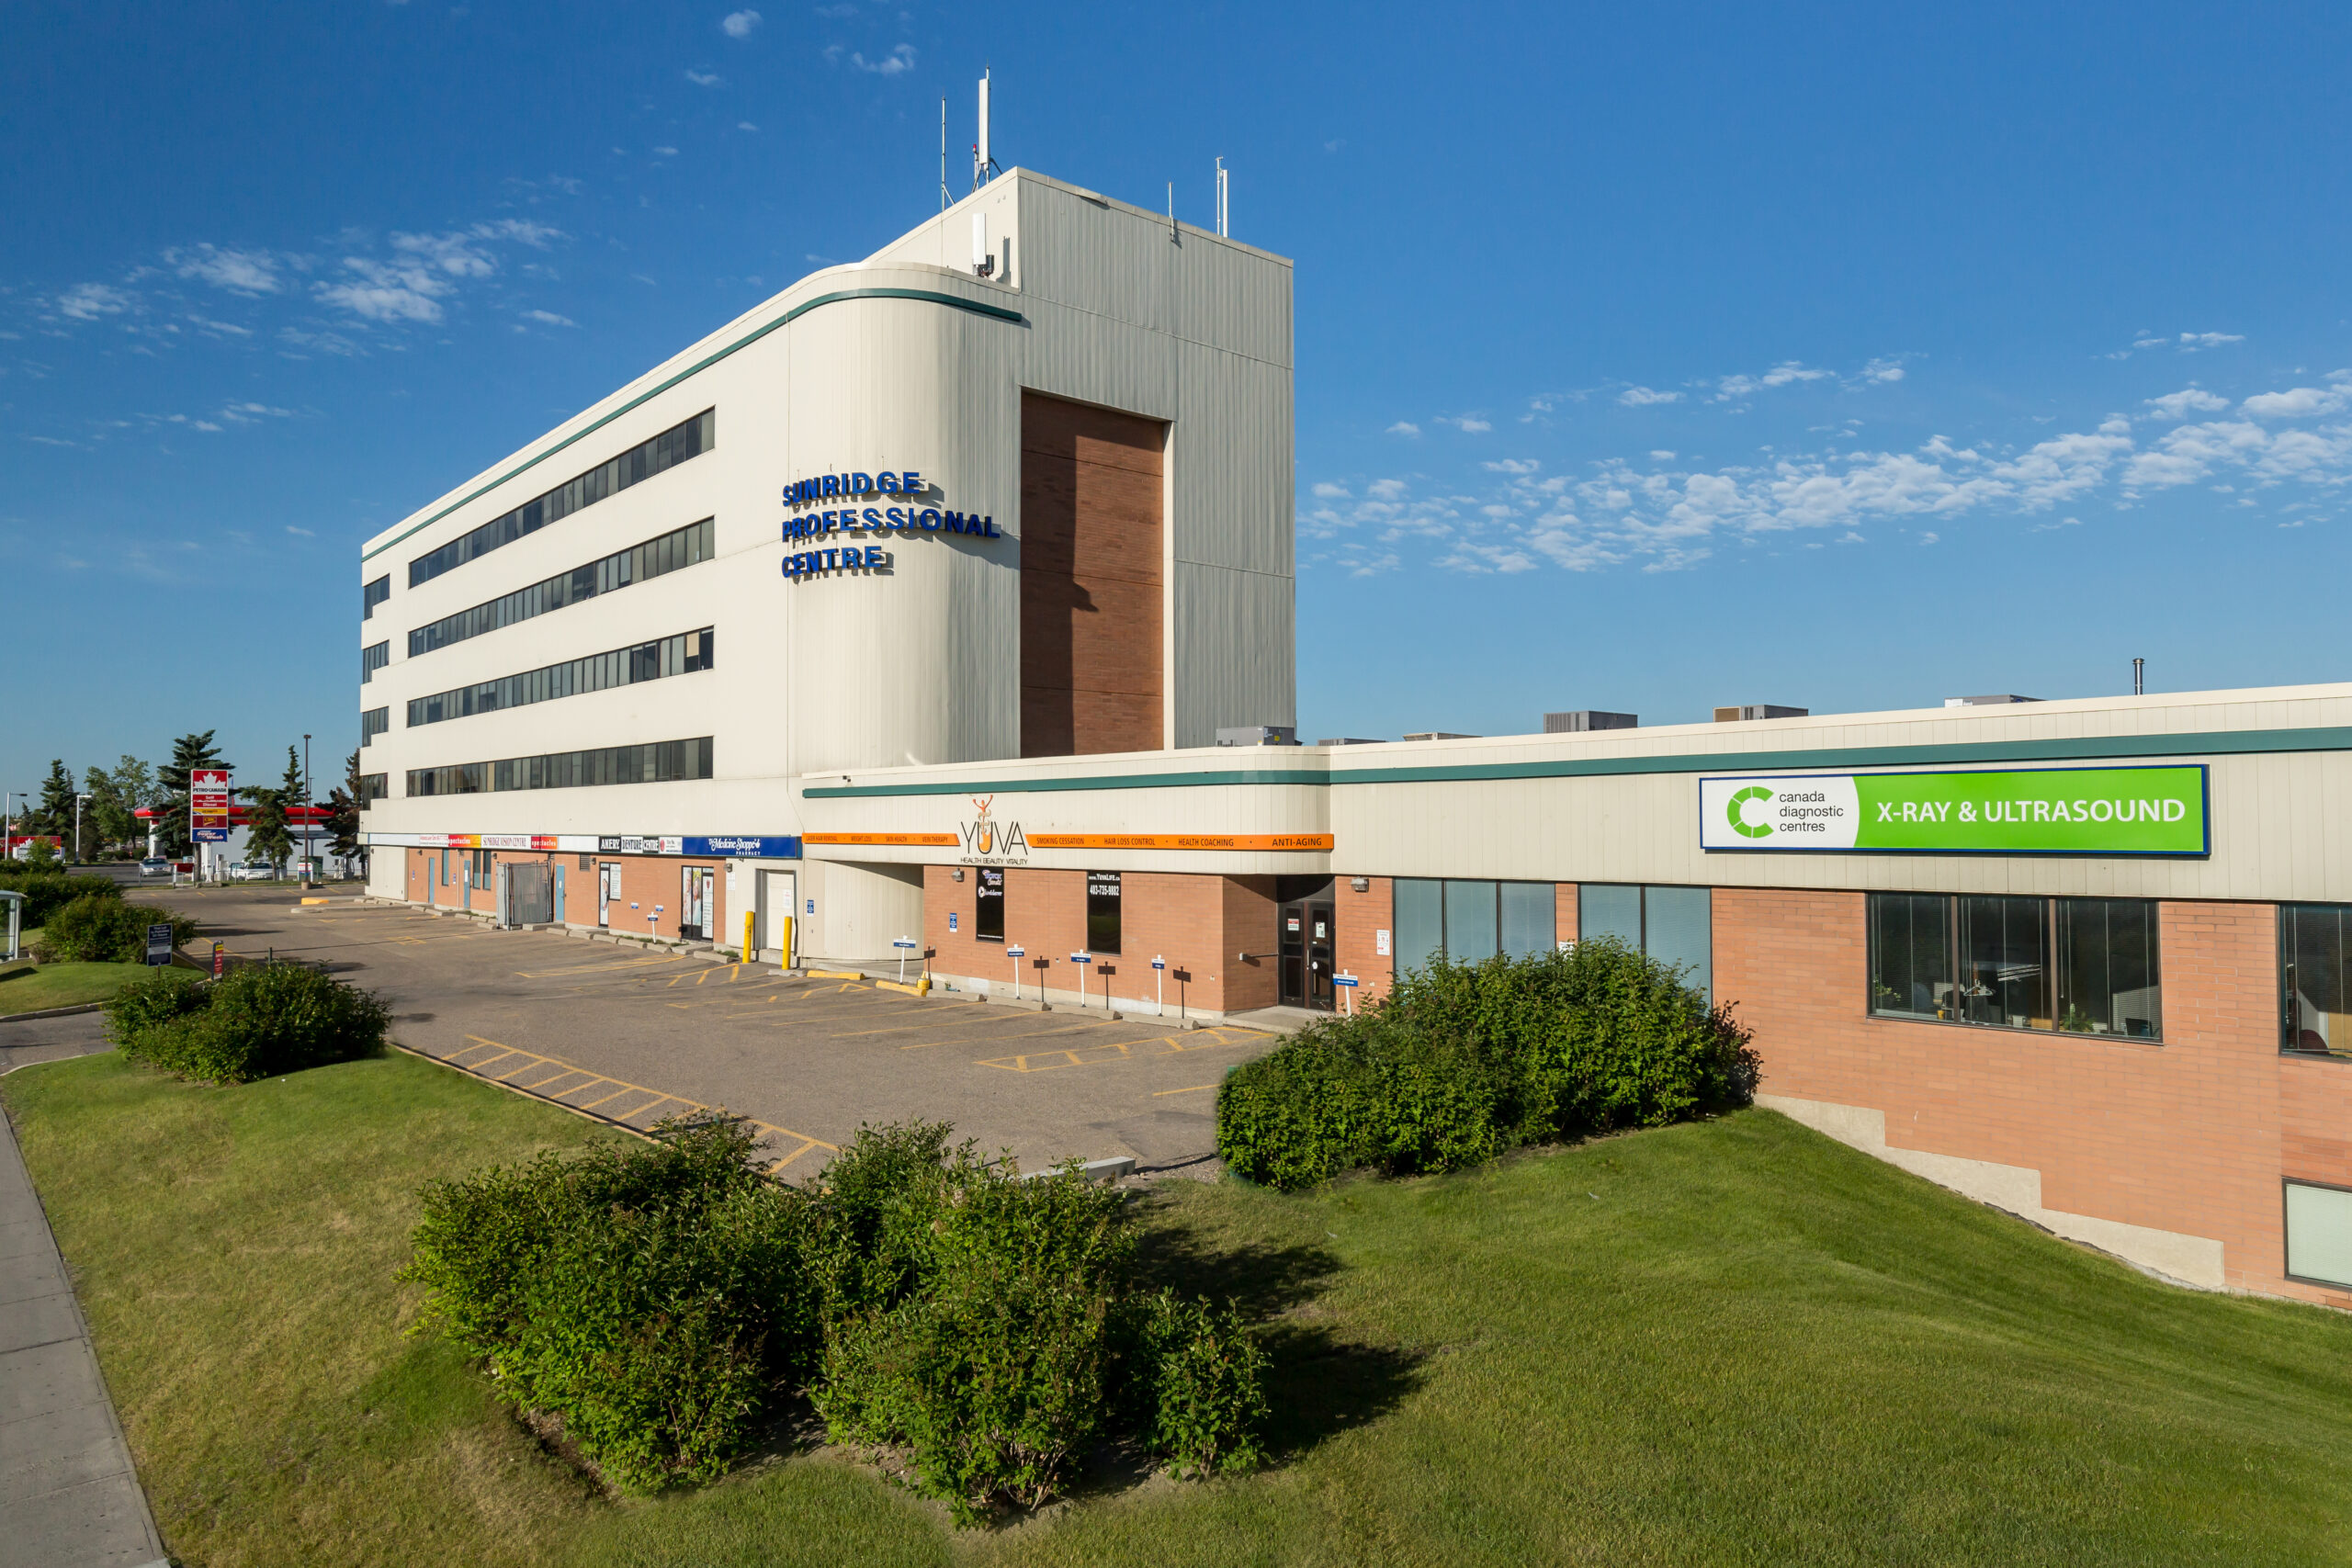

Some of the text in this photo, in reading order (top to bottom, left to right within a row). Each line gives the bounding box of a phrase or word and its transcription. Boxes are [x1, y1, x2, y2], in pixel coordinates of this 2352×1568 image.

[783, 471, 920, 506] SUNRIDGE
[782, 507, 1001, 542] PROFESSIONAL
[782, 546, 882, 578] CENTRE
[1779, 791, 1826, 803] canada
[1779, 806, 1844, 820] diagnostic
[1877, 799, 2187, 822] X-RAY & ULTRASOUND
[1779, 821, 1826, 832] centres
[622, 839, 642, 851] DENTURE
[643, 839, 659, 851] CENTRE
[711, 838, 736, 852] Medicine
[960, 820, 1028, 856] YUVA
[1104, 837, 1116, 845] HAIR
[1117, 837, 1130, 845] LOSS
[1131, 838, 1156, 846] CONTROL
[1178, 838, 1199, 846] HEALTH
[1200, 838, 1234, 847] COACHING
[1272, 838, 1322, 847] ANTI-AGING
